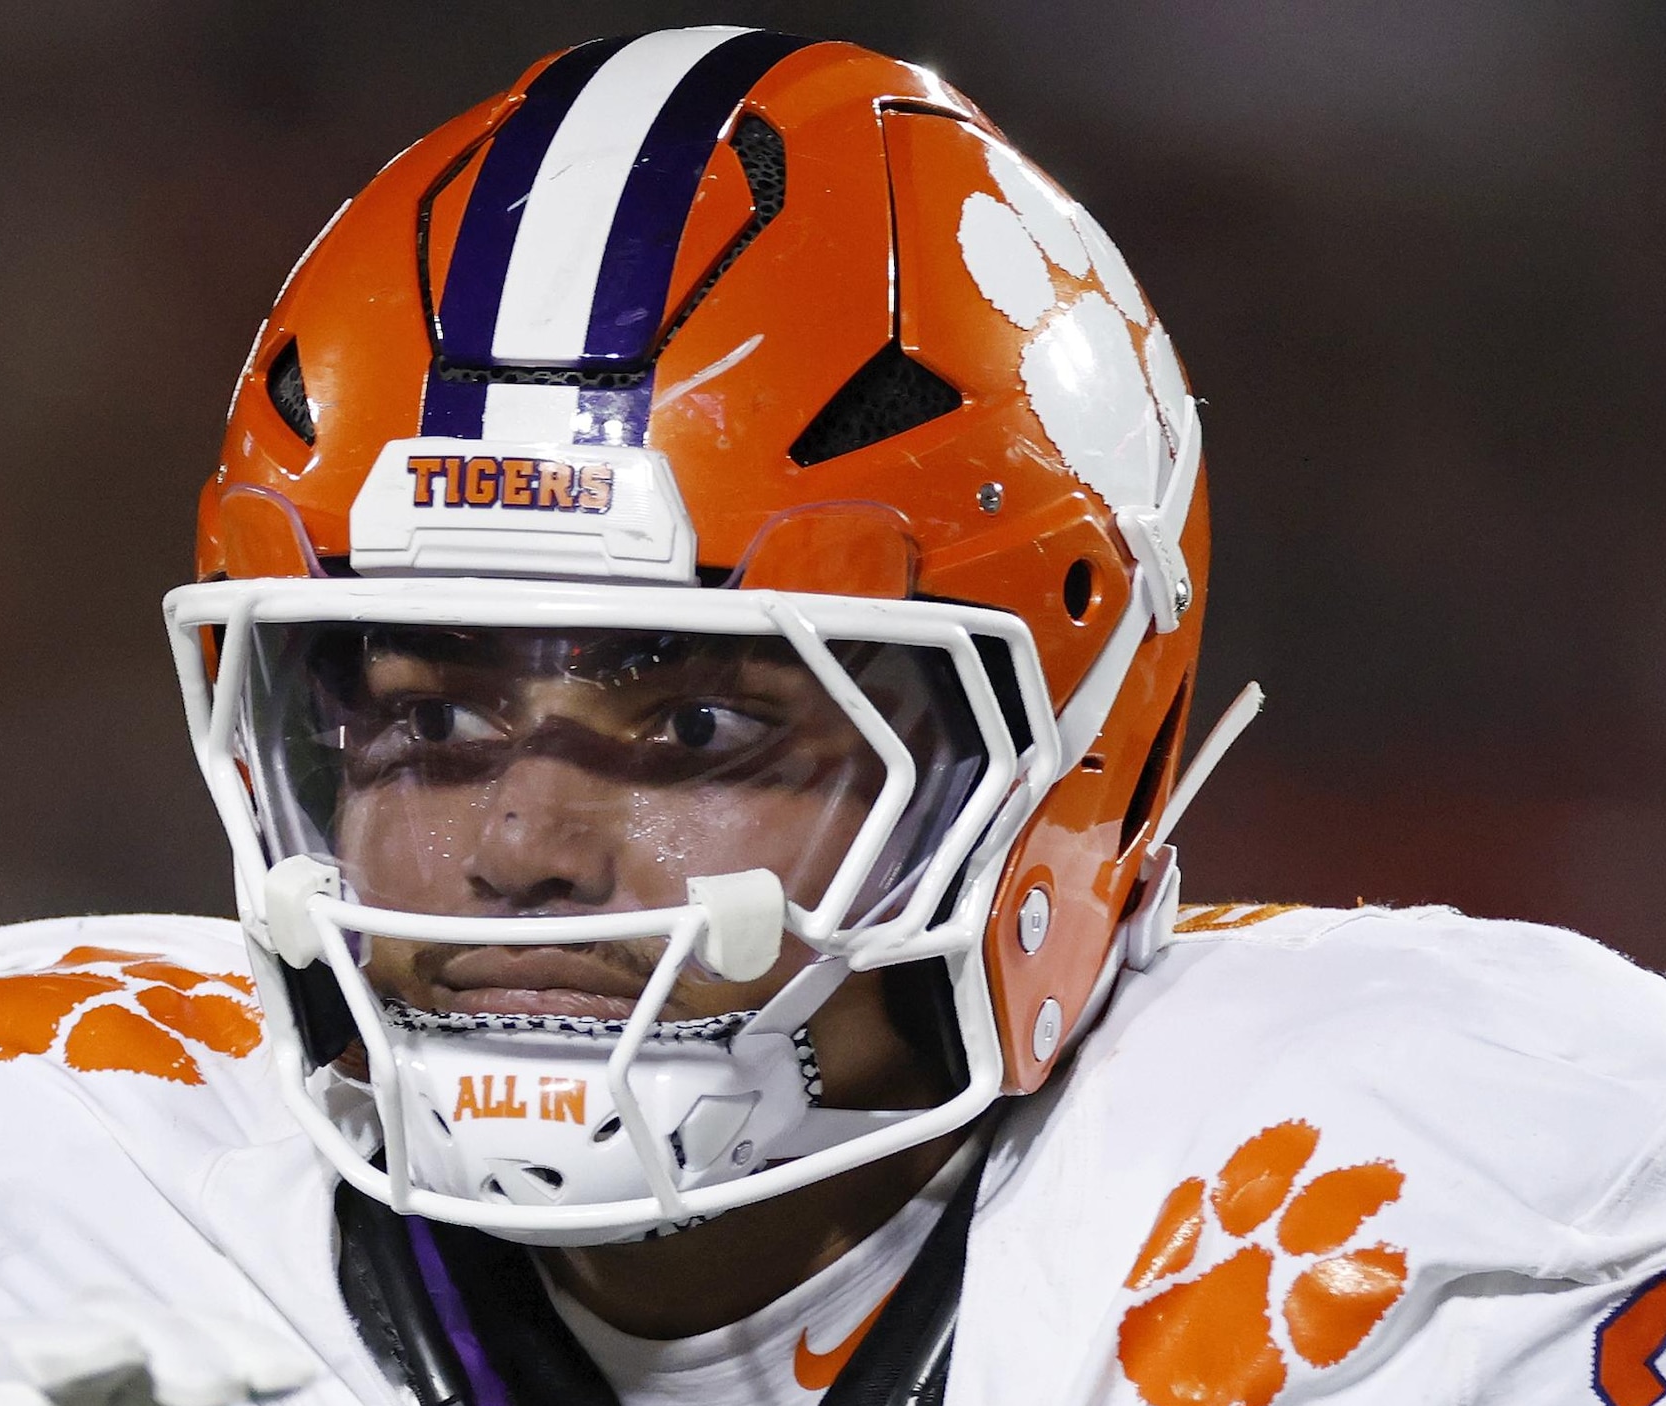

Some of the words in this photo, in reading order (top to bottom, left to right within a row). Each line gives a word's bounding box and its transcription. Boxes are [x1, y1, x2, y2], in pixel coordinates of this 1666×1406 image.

[407, 455, 614, 515] TIGERS
[453, 1074, 527, 1122] ALL
[539, 1076, 587, 1126] IN
